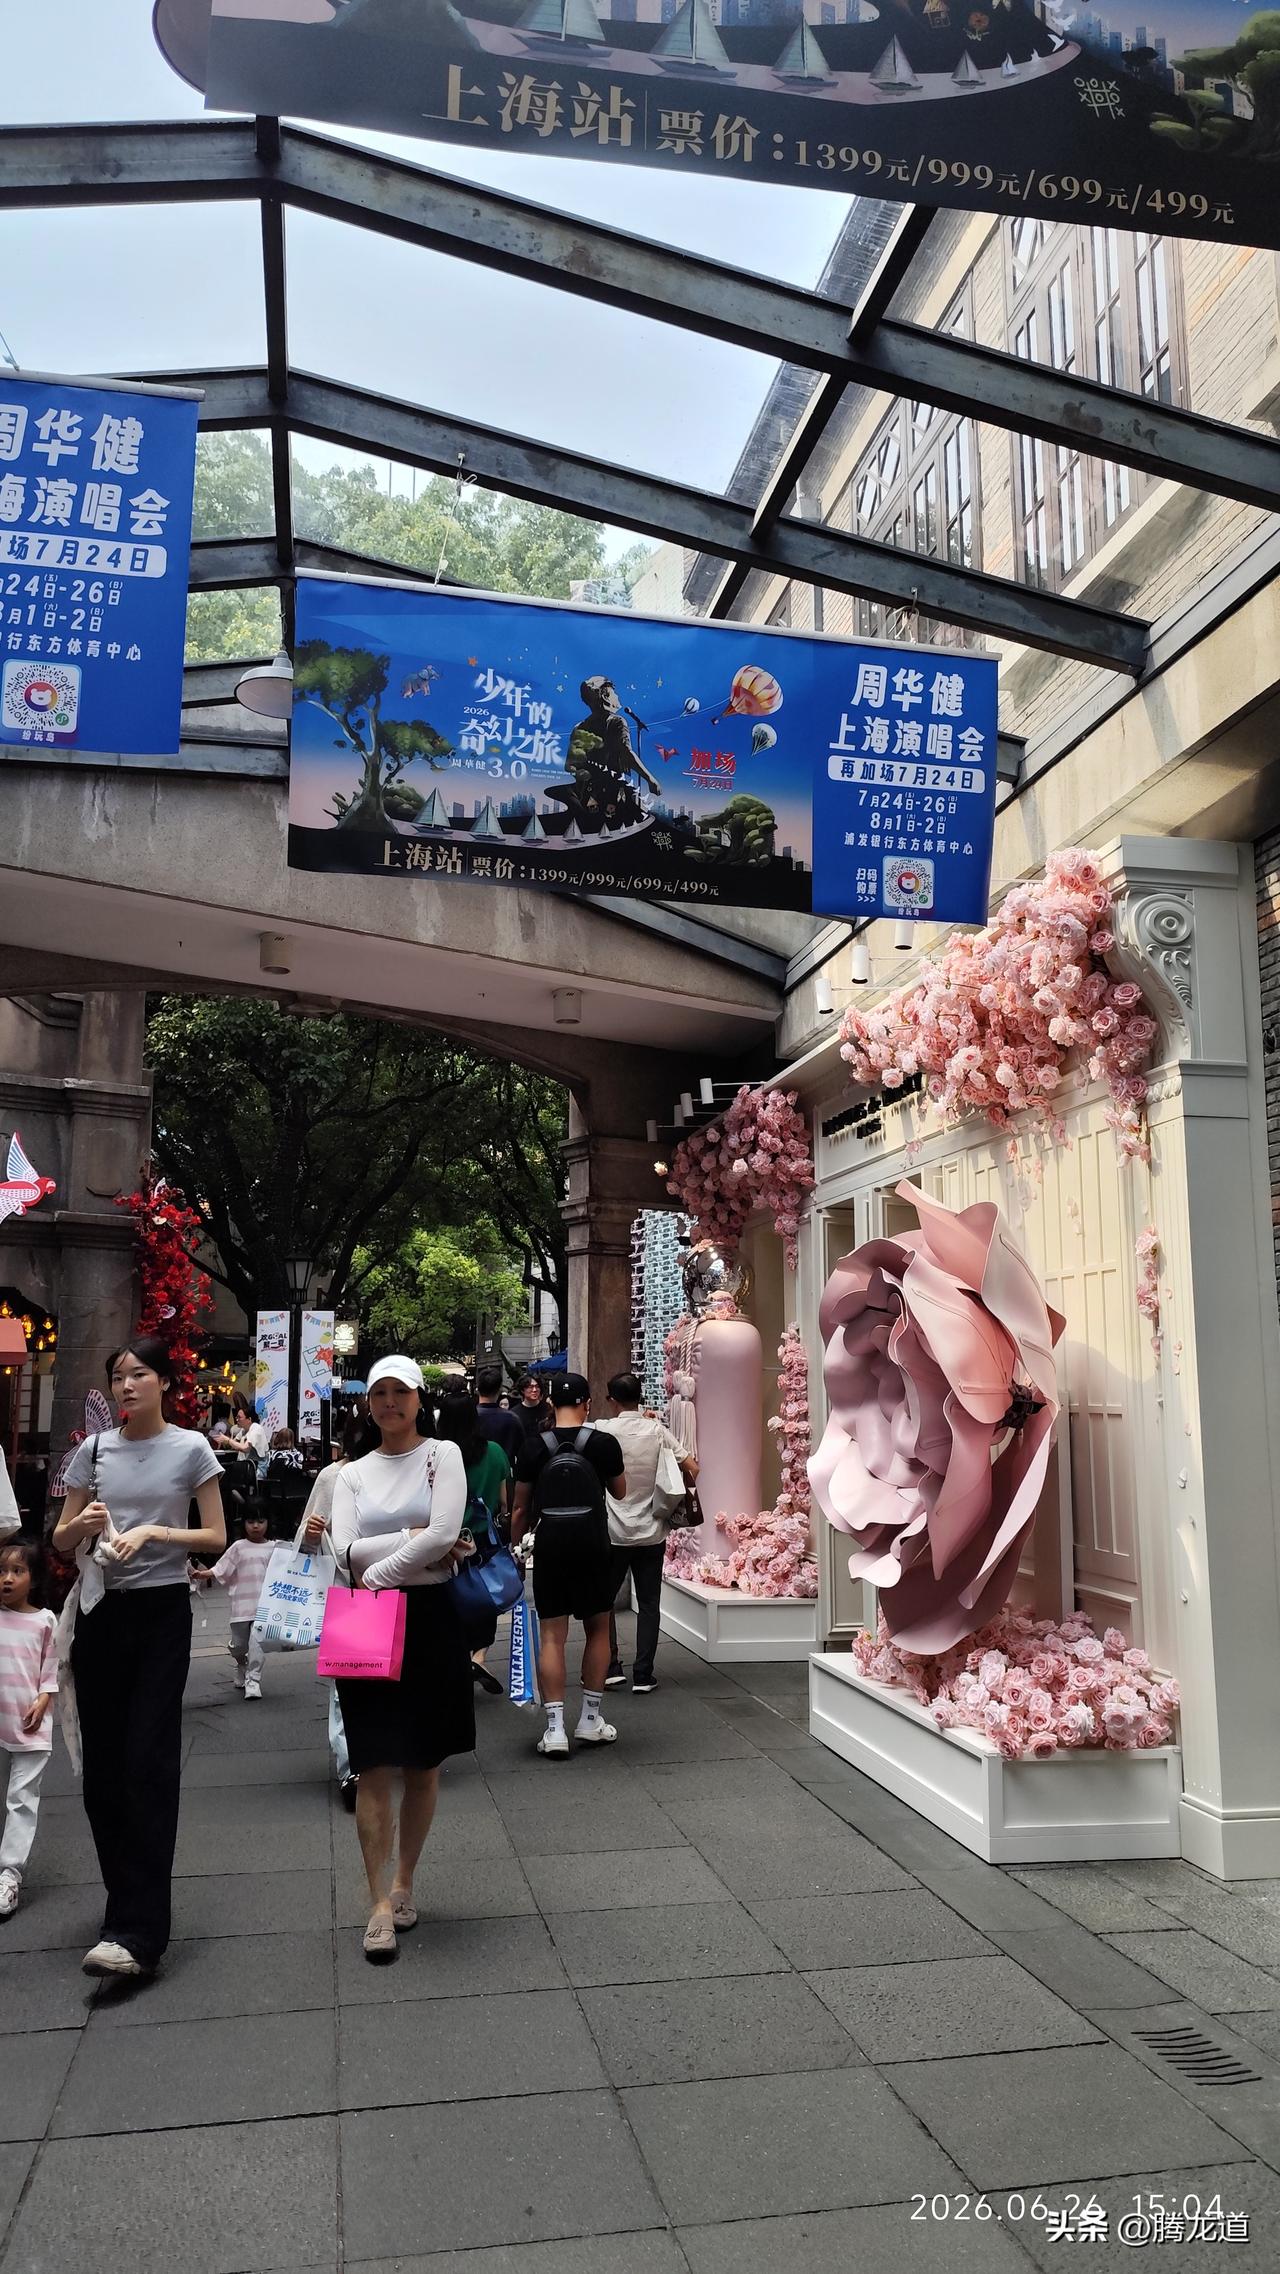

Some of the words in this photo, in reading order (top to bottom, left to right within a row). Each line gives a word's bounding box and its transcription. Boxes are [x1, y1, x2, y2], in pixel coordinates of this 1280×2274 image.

[421, 63, 638, 147] 上海站
[0, 534, 150, 573] 场7月24日
[0, 631, 142, 661] 行东方体育中心
[474, 668, 553, 729] 少年的
[850, 663, 965, 717] 周华健
[463, 706, 490, 716] 2026
[458, 714, 564, 766] 奇幻之旅
[829, 712, 985, 762] 上海演唱会
[487, 758, 528, 781] 3.0
[840, 759, 974, 790] 再加场7月24日
[373, 839, 464, 875] 上海站
[844, 831, 973, 855] 浦发银行东方体育中心
[855, 867, 878, 882] 扫码
[510, 1604, 525, 1698] ARGENTINA
